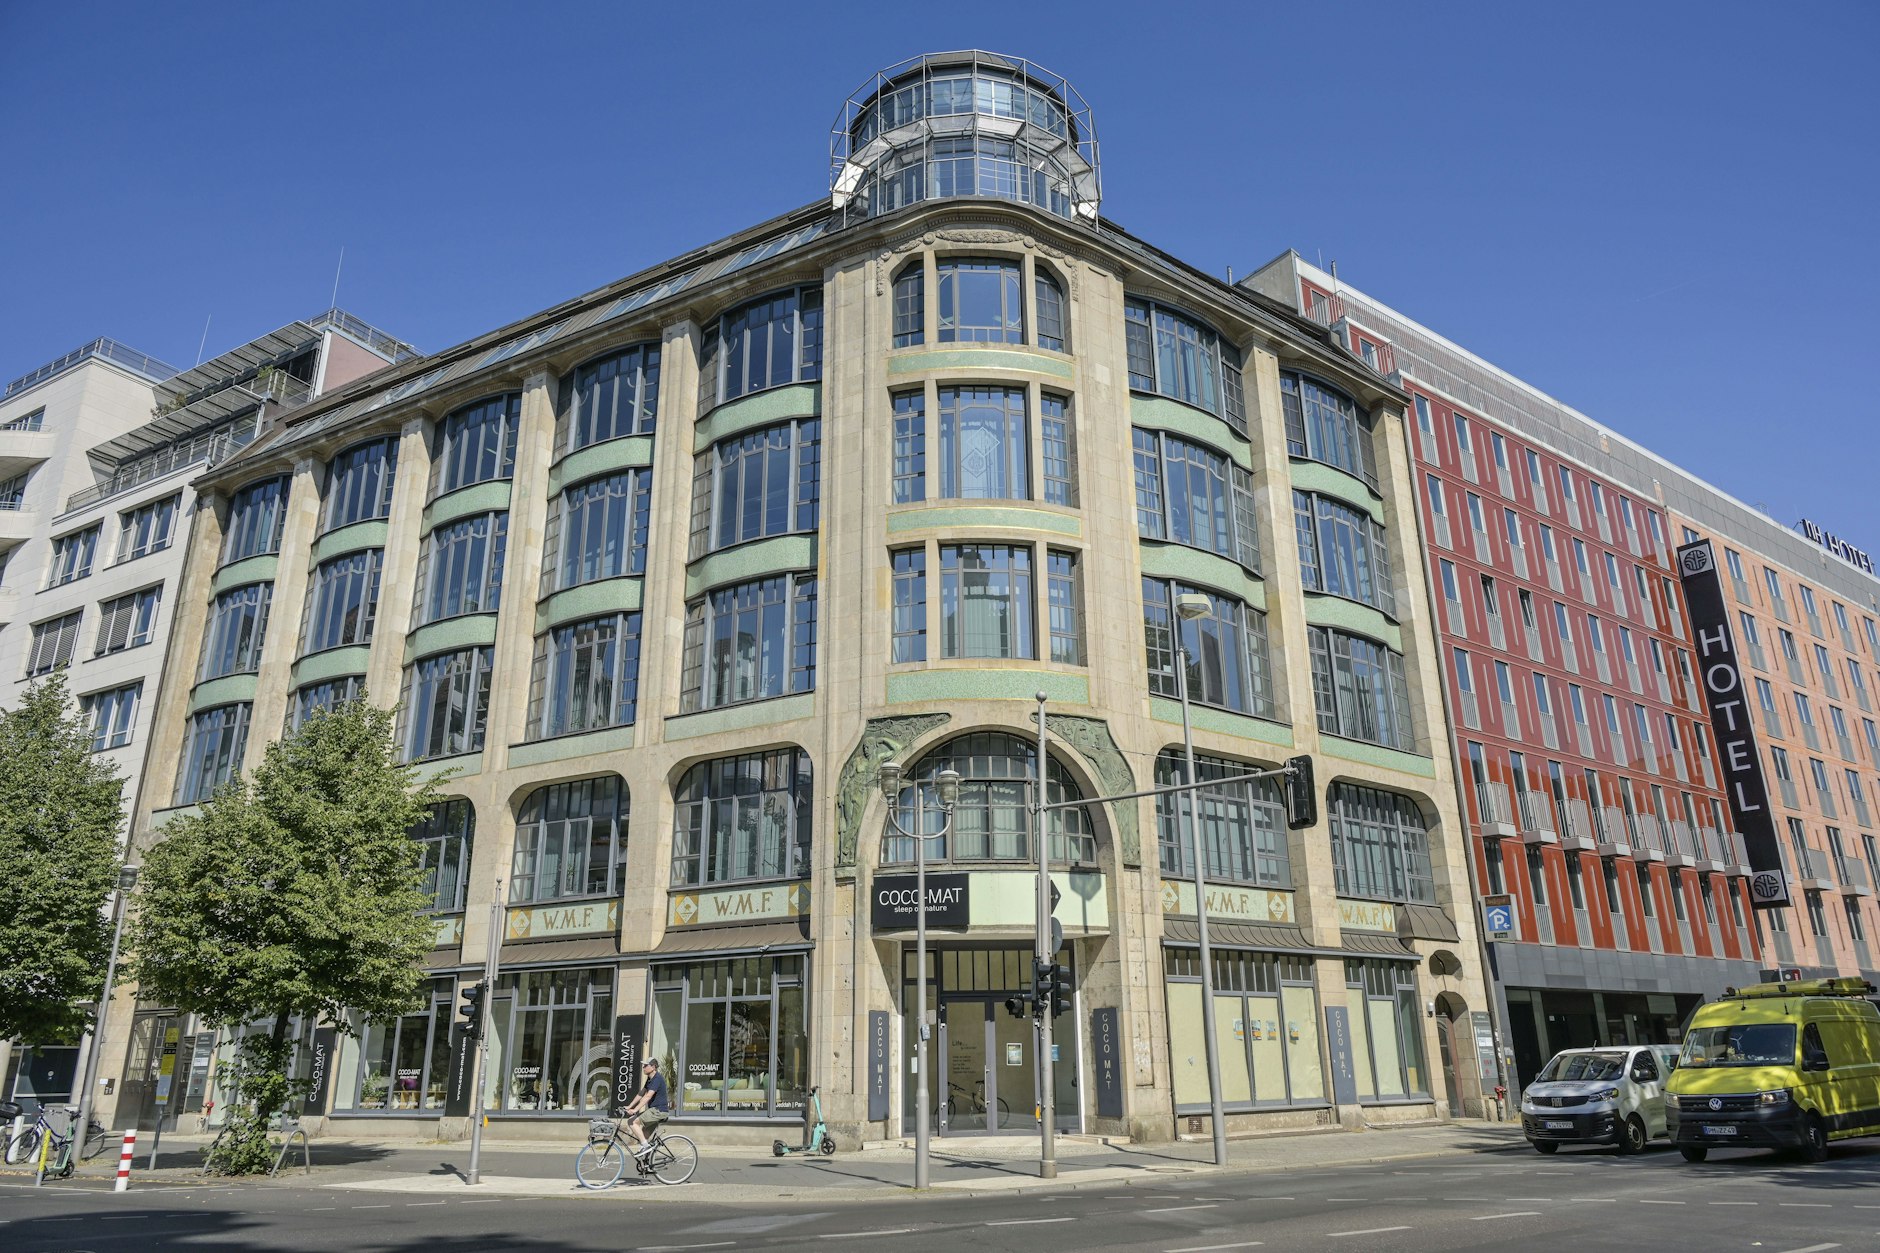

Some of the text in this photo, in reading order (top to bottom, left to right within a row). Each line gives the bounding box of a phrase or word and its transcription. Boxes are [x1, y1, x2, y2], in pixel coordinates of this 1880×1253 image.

[1699, 624, 1760, 812] HOTEL
[713, 891, 774, 916] W.M.F.
[879, 888, 963, 906] COCO-MAT
[543, 907, 594, 930] W.M.F.
[894, 906, 913, 914] sleep
[1494, 914, 1505, 929] P
[1102, 1013, 1112, 1090] COCO MAT
[1335, 1010, 1347, 1078] COCO MAT
[617, 1032, 631, 1102] COCO-MAT
